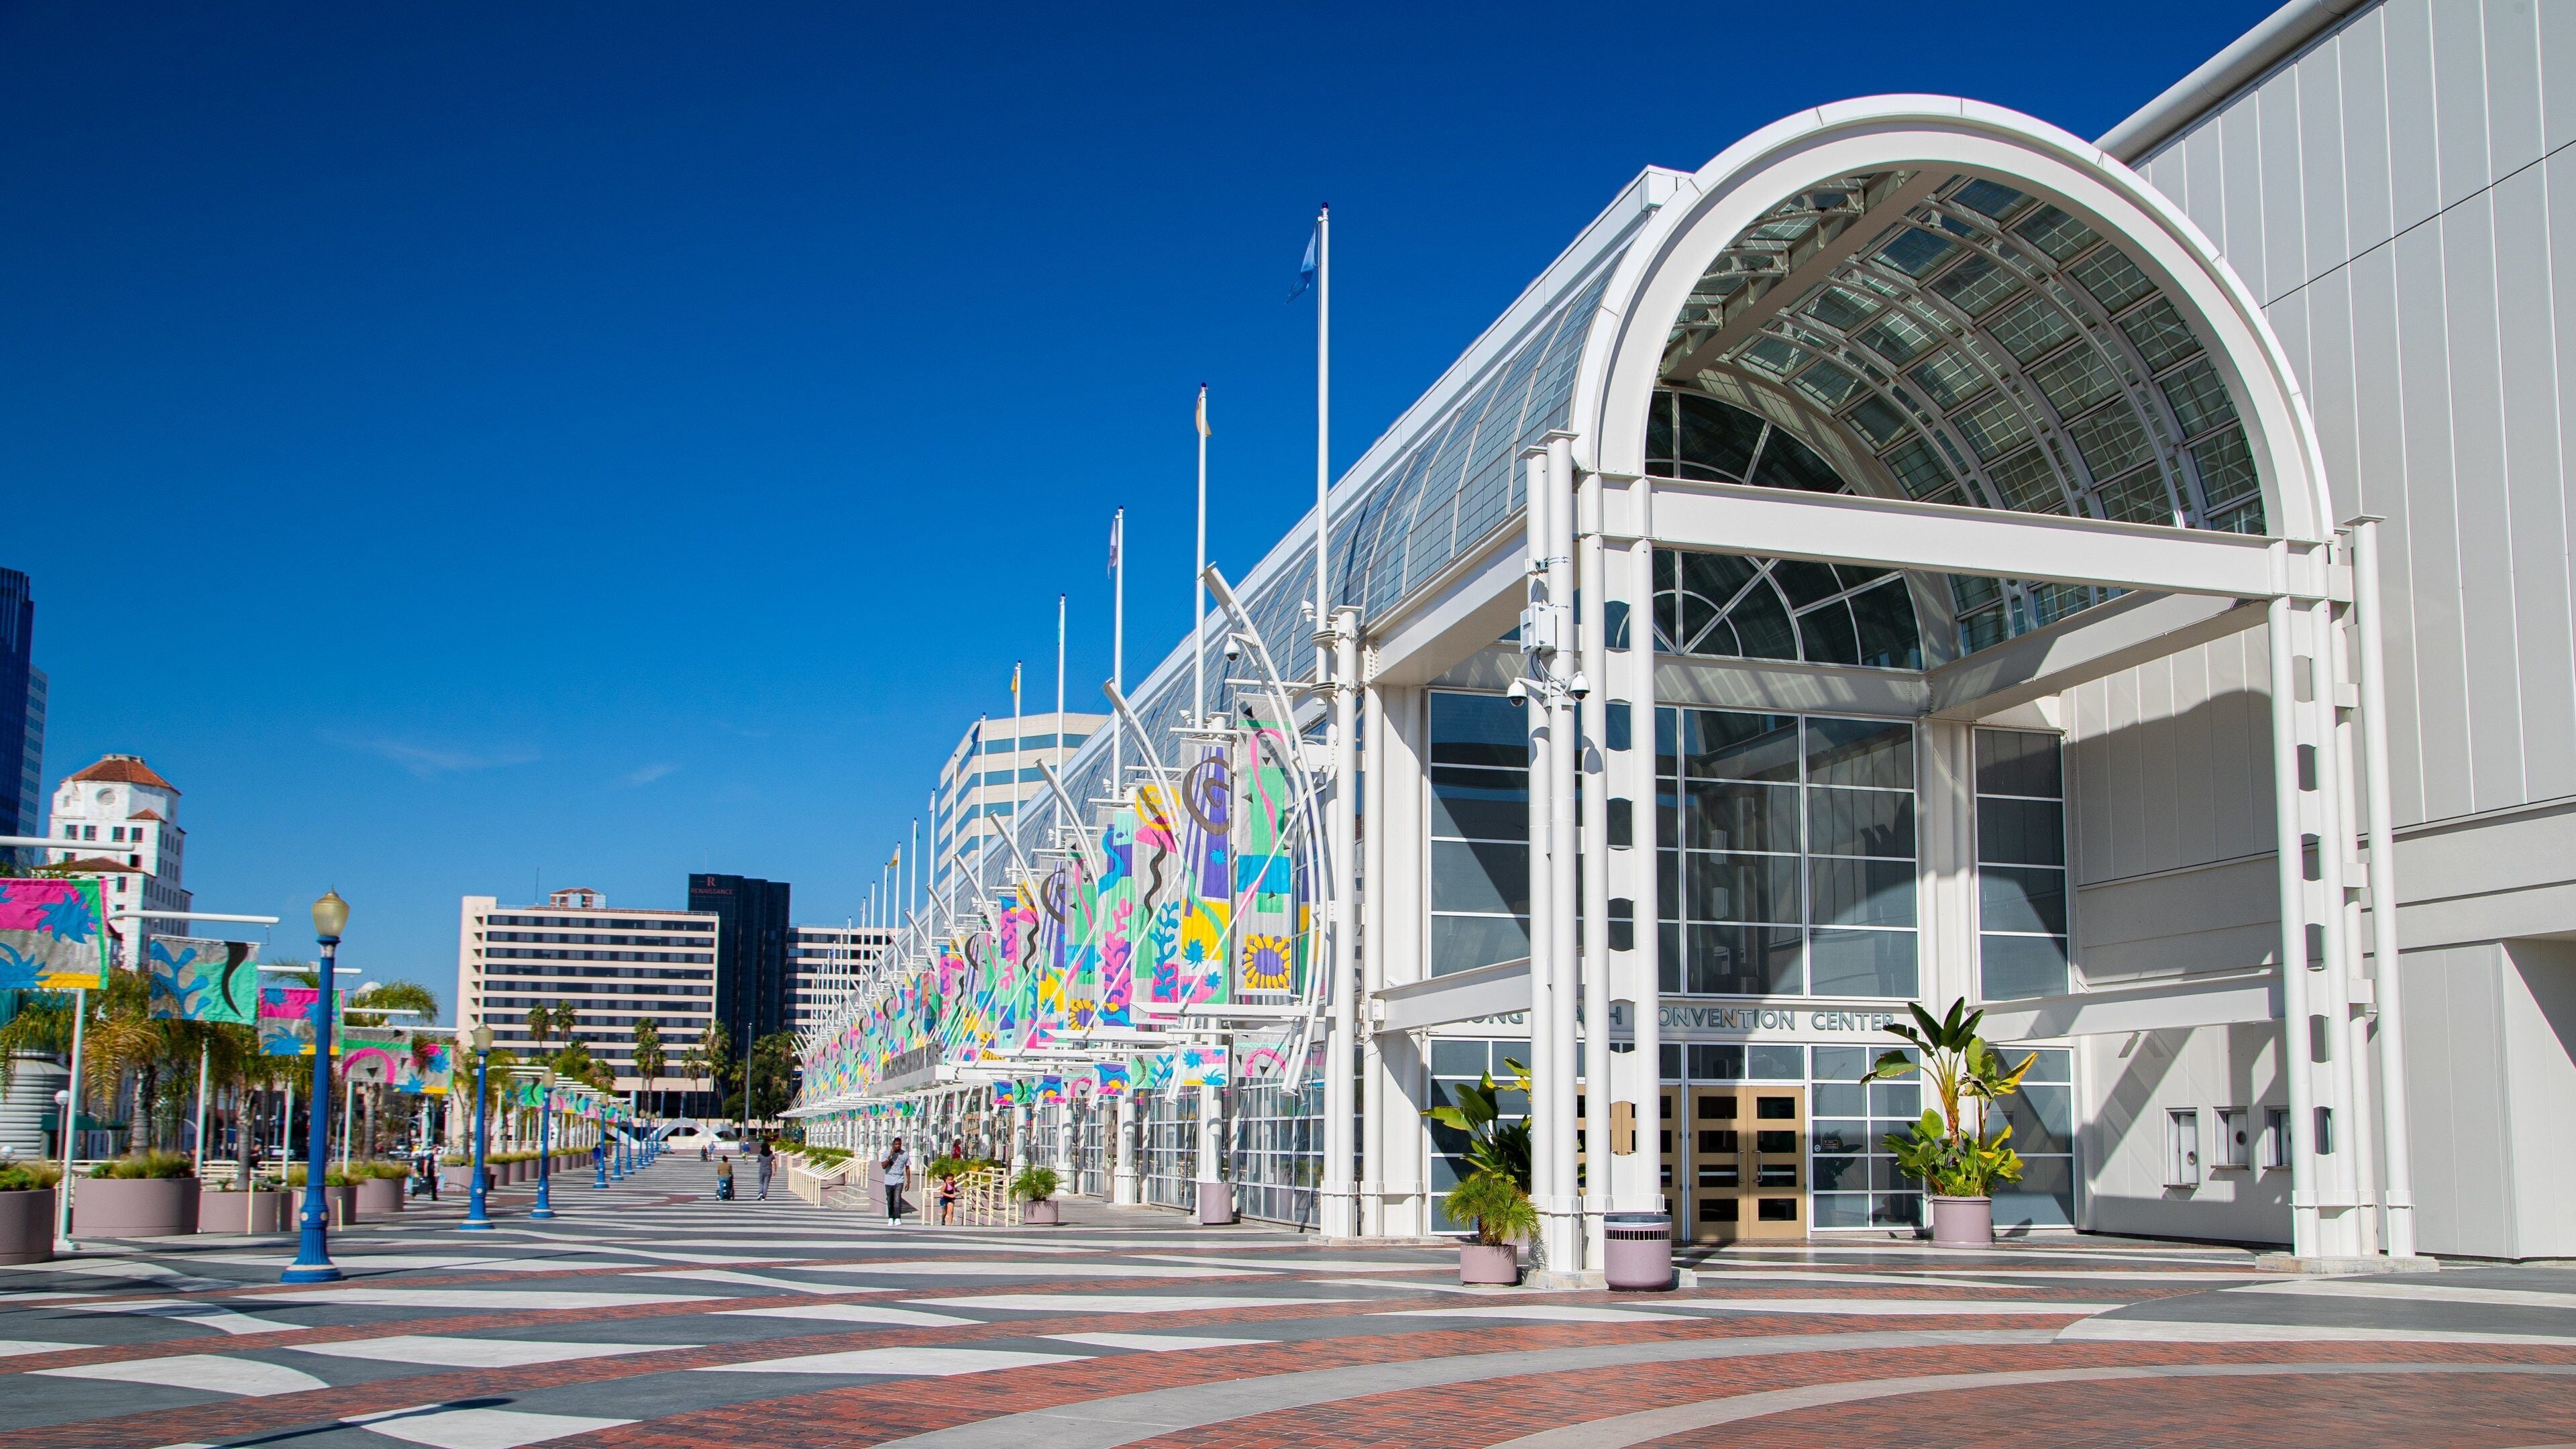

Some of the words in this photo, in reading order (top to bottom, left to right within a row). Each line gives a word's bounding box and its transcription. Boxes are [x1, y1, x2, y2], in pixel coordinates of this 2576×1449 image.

[706, 876, 716, 886] R
[1658, 1006, 1795, 1030] ONVENTION
[1811, 1010, 1894, 1031] CENTER
